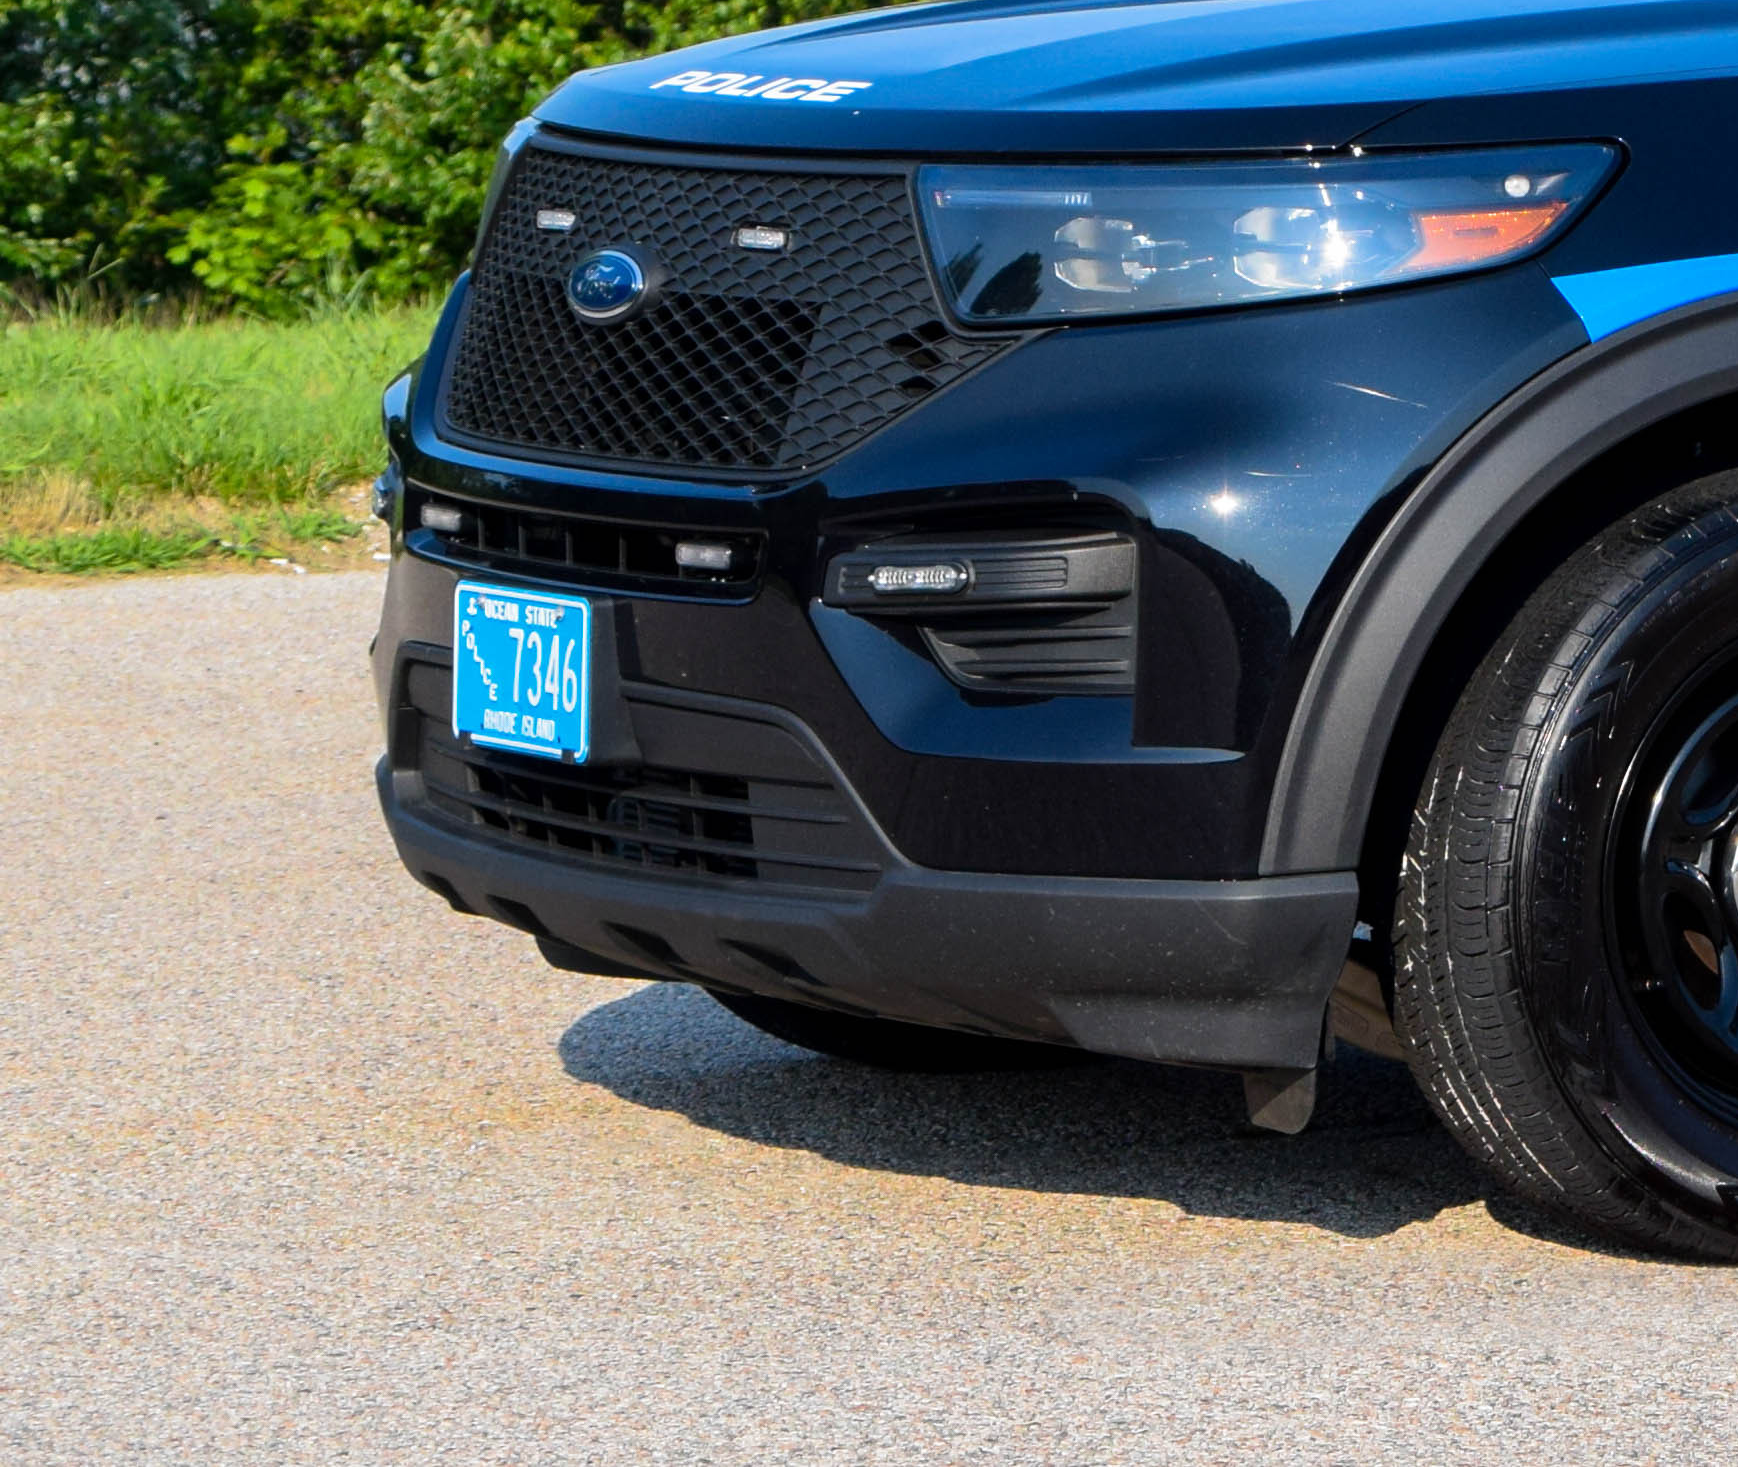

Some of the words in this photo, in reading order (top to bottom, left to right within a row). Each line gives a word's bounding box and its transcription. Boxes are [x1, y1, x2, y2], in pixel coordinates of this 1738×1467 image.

[649, 70, 873, 102] POLICE
[484, 597, 519, 622] OCEAN
[525, 605, 559, 629] STATE
[461, 619, 498, 701] POLICE
[509, 628, 577, 713] 7346
[484, 708, 517, 734] RHODE
[522, 715, 555, 742] ISLAND
